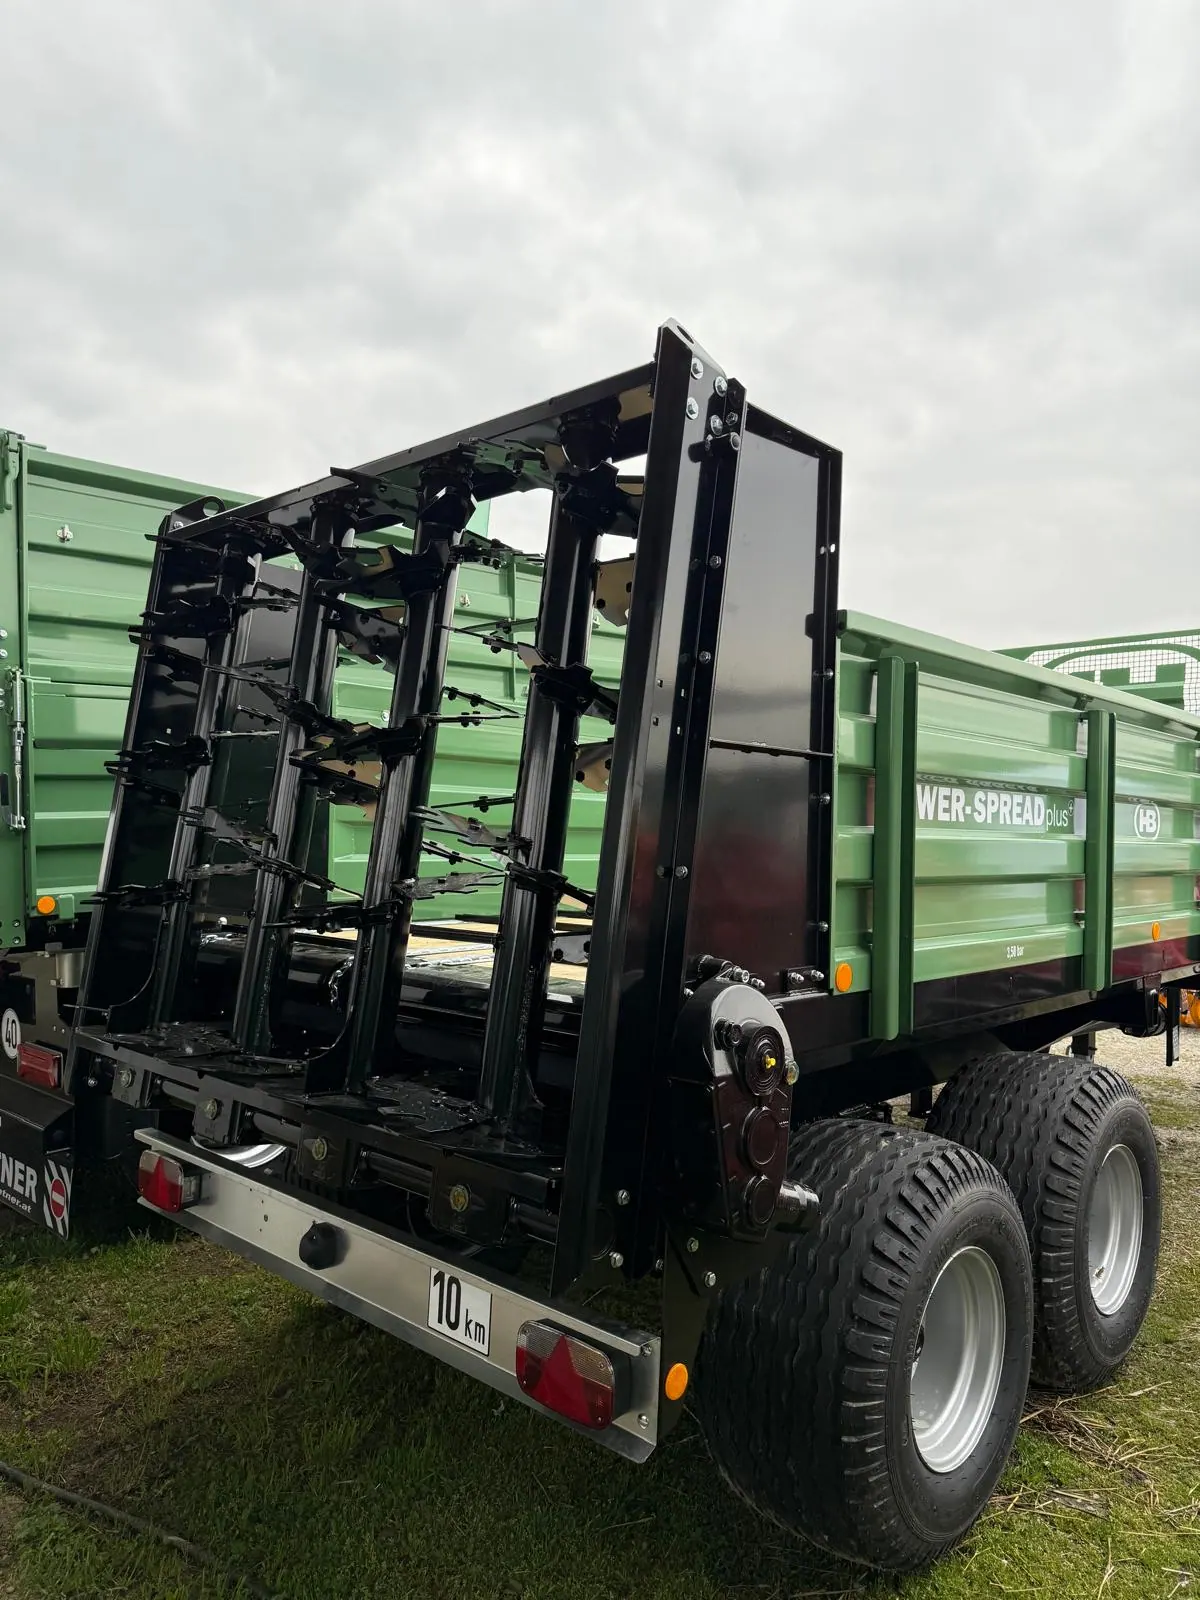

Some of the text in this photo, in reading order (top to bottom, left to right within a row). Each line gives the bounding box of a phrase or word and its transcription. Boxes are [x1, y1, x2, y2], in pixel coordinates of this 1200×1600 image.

[1017, 944, 1025, 957] bar
[5, 1017, 17, 1049] 40
[0, 1151, 37, 1204] NER
[433, 1270, 486, 1345] 10 km
